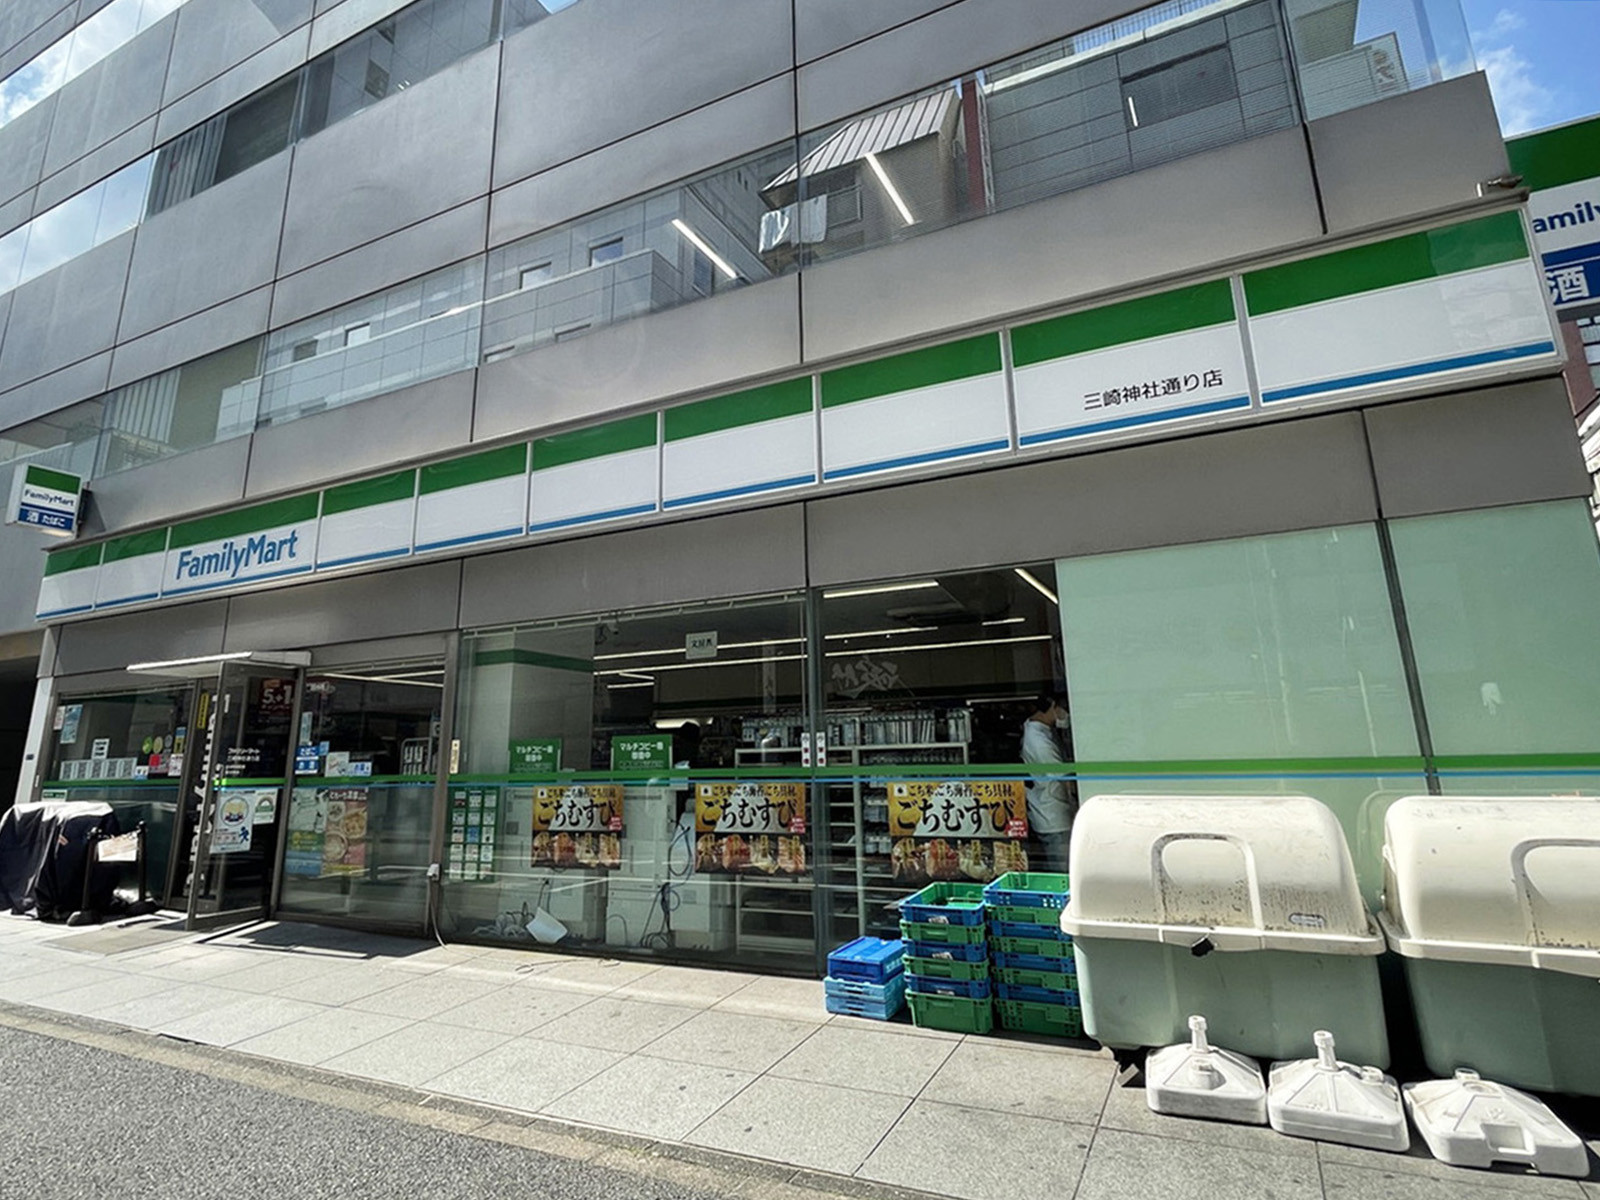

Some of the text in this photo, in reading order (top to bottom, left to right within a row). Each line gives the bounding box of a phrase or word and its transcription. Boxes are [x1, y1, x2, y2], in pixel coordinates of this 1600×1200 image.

[1084, 369, 1223, 410] 三崎神社通り店
[24, 489, 74, 506] FamilyMart
[41, 514, 66, 527] たばこ
[176, 530, 298, 580] FamilyMart
[538, 797, 619, 829] ごちむすび
[702, 797, 798, 831] ごちむすび
[897, 798, 1016, 834] ごちむすび
